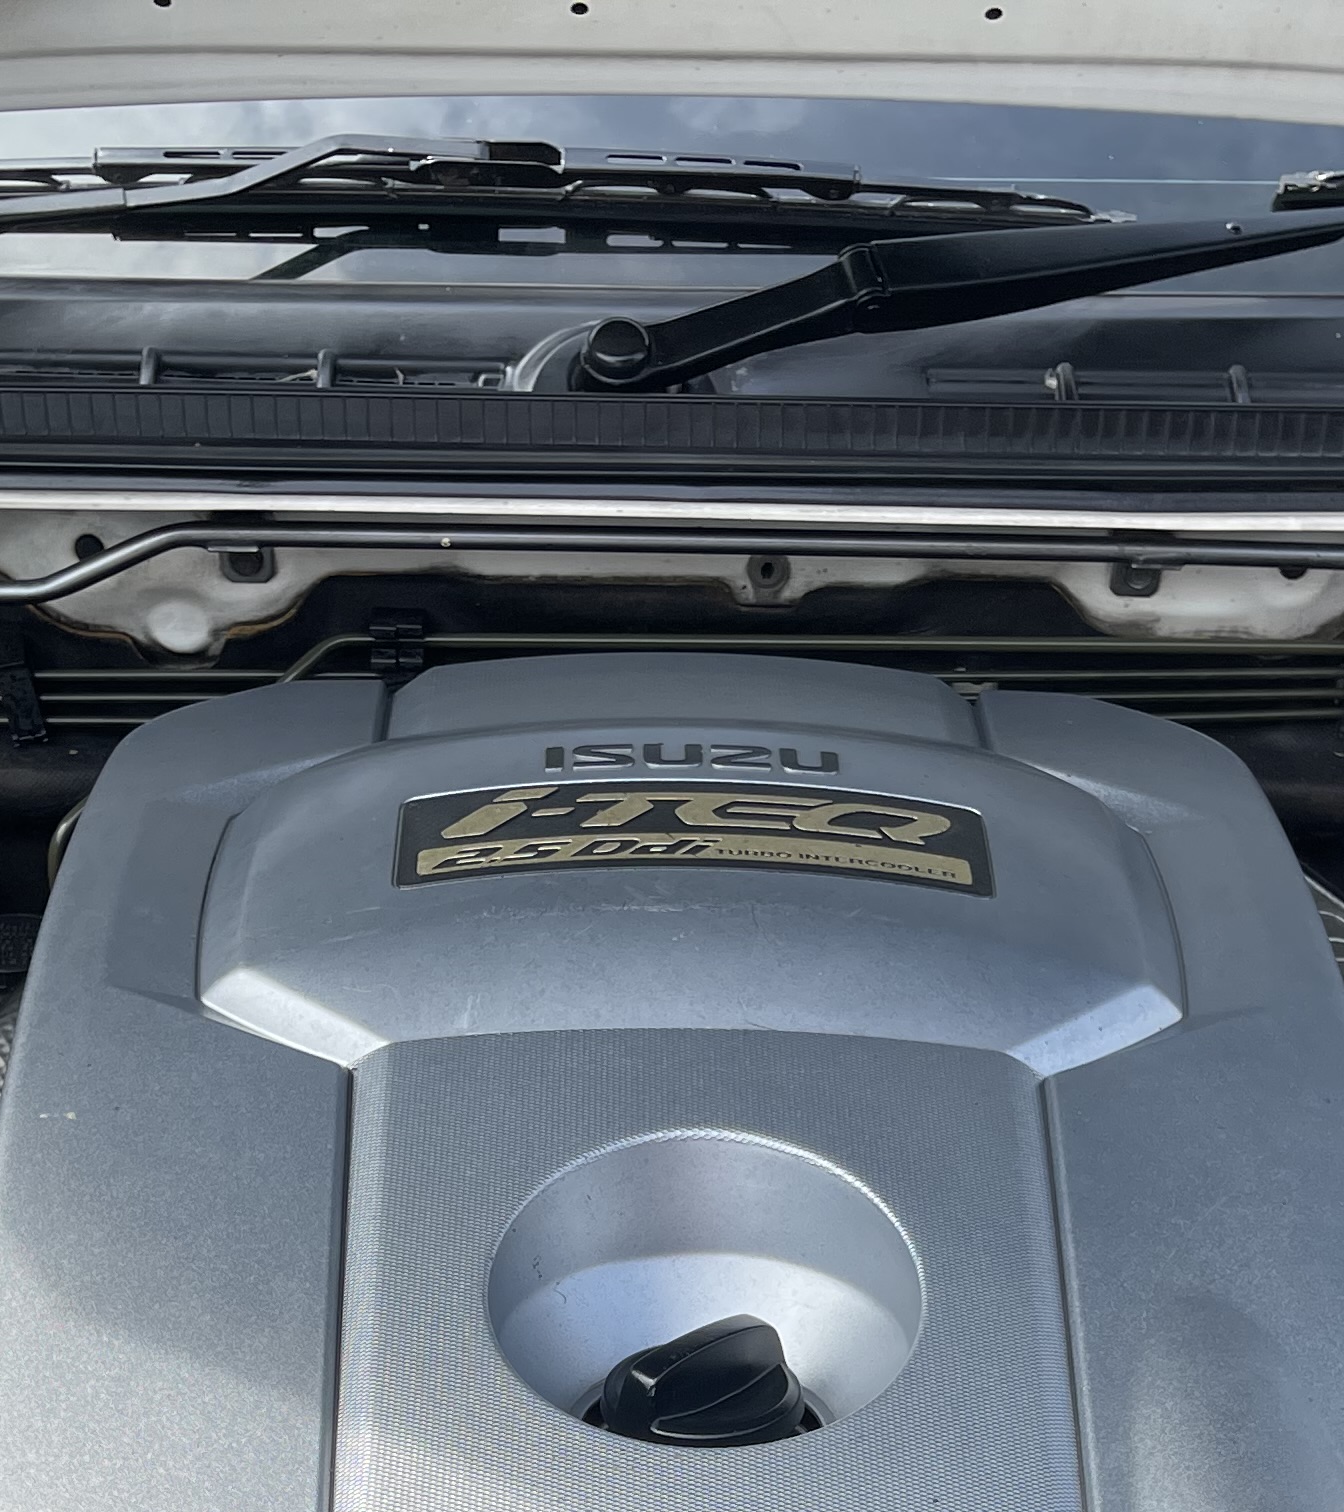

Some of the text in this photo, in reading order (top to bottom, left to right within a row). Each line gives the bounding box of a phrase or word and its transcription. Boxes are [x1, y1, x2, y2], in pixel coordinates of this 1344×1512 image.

[545, 743, 840, 776] ISUZU
[714, 847, 792, 860] TURBO
[798, 853, 958, 880] INTERCOOLER
